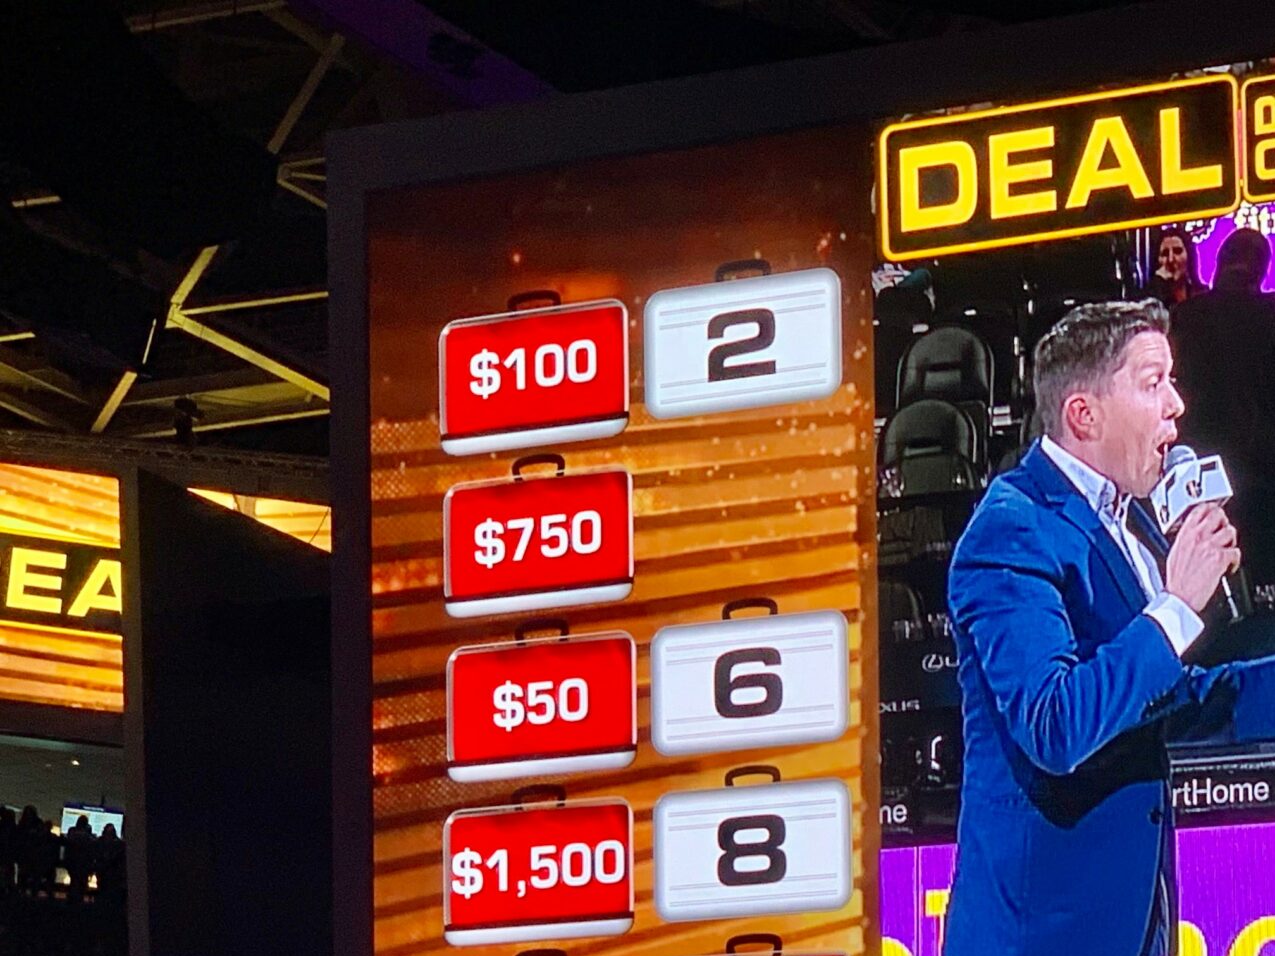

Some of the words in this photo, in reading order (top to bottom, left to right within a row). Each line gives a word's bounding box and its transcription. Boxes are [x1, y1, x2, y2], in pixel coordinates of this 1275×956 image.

[899, 107, 1223, 232] DEAL
[469, 338, 598, 399] $100
[706, 307, 777, 383] 2
[473, 510, 603, 569] $750
[492, 678, 589, 731] $50
[714, 647, 784, 719] 6
[451, 839, 625, 899] $1,500
[717, 814, 786, 887] 8
